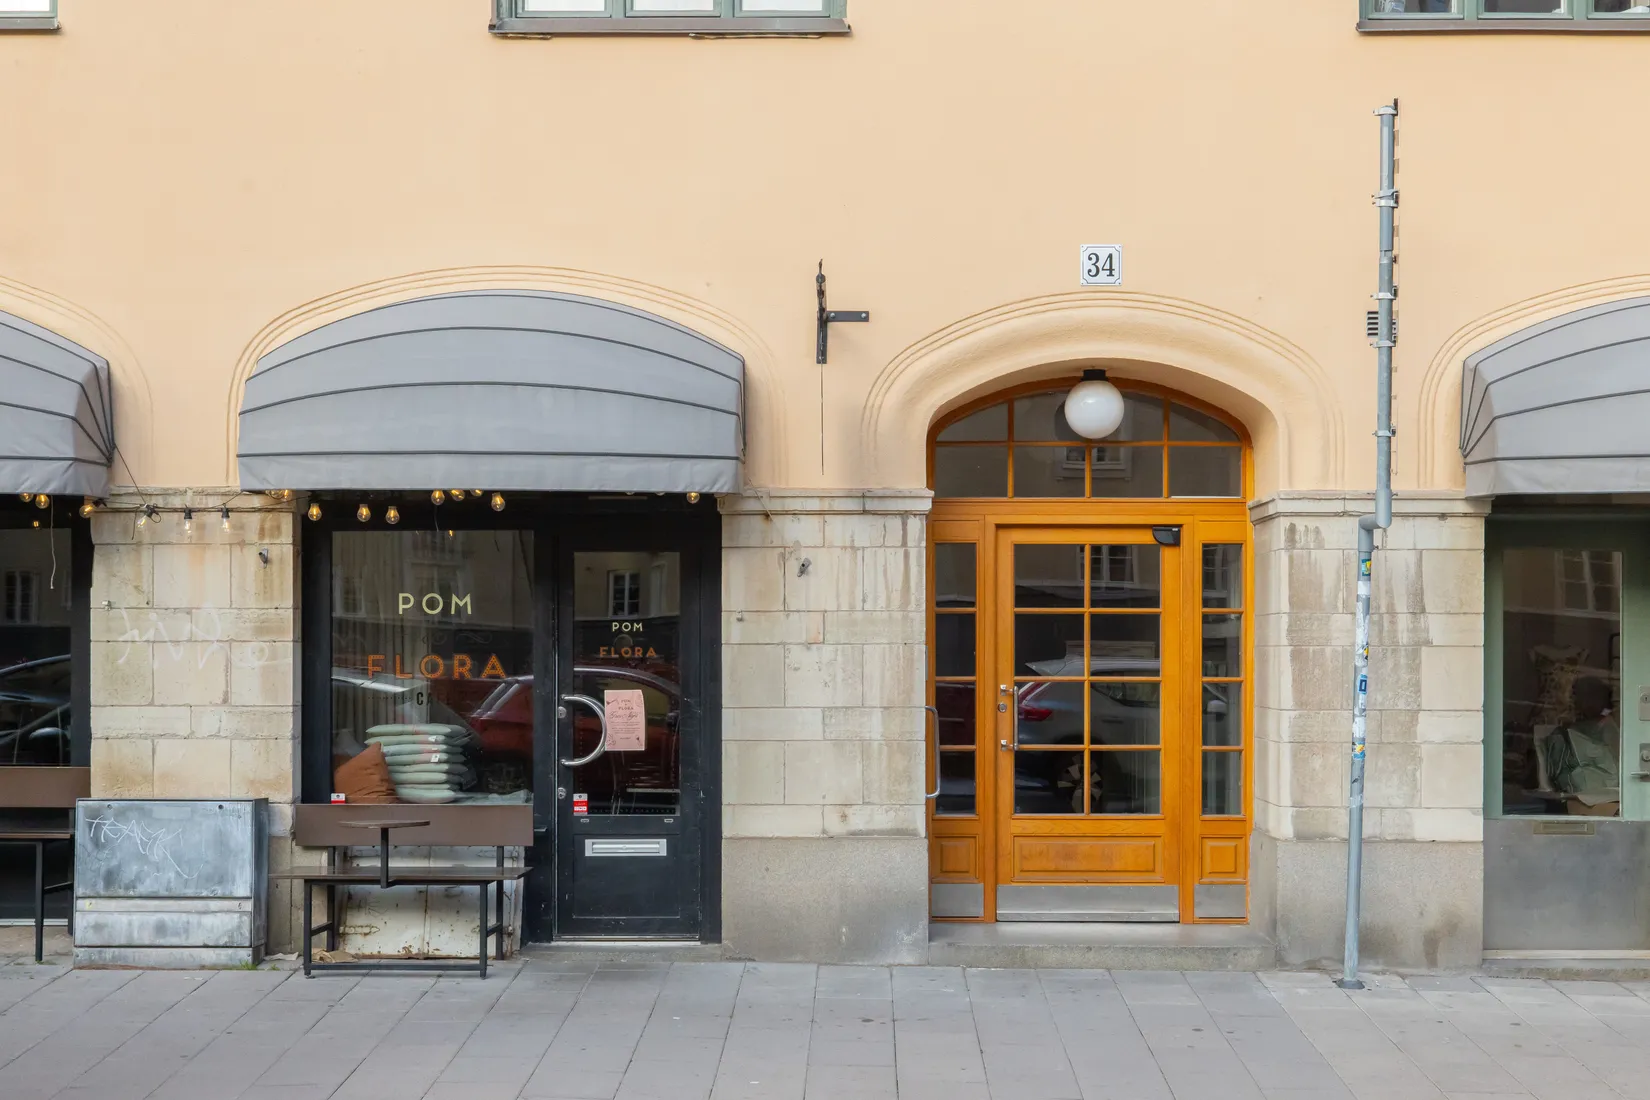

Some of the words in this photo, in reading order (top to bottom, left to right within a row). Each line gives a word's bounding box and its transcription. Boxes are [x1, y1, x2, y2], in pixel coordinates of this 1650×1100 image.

[1087, 252, 1116, 278] 34
[398, 592, 472, 615] POM
[612, 622, 643, 632] POM
[599, 646, 657, 657] FLORA
[367, 654, 507, 679] FLORA
